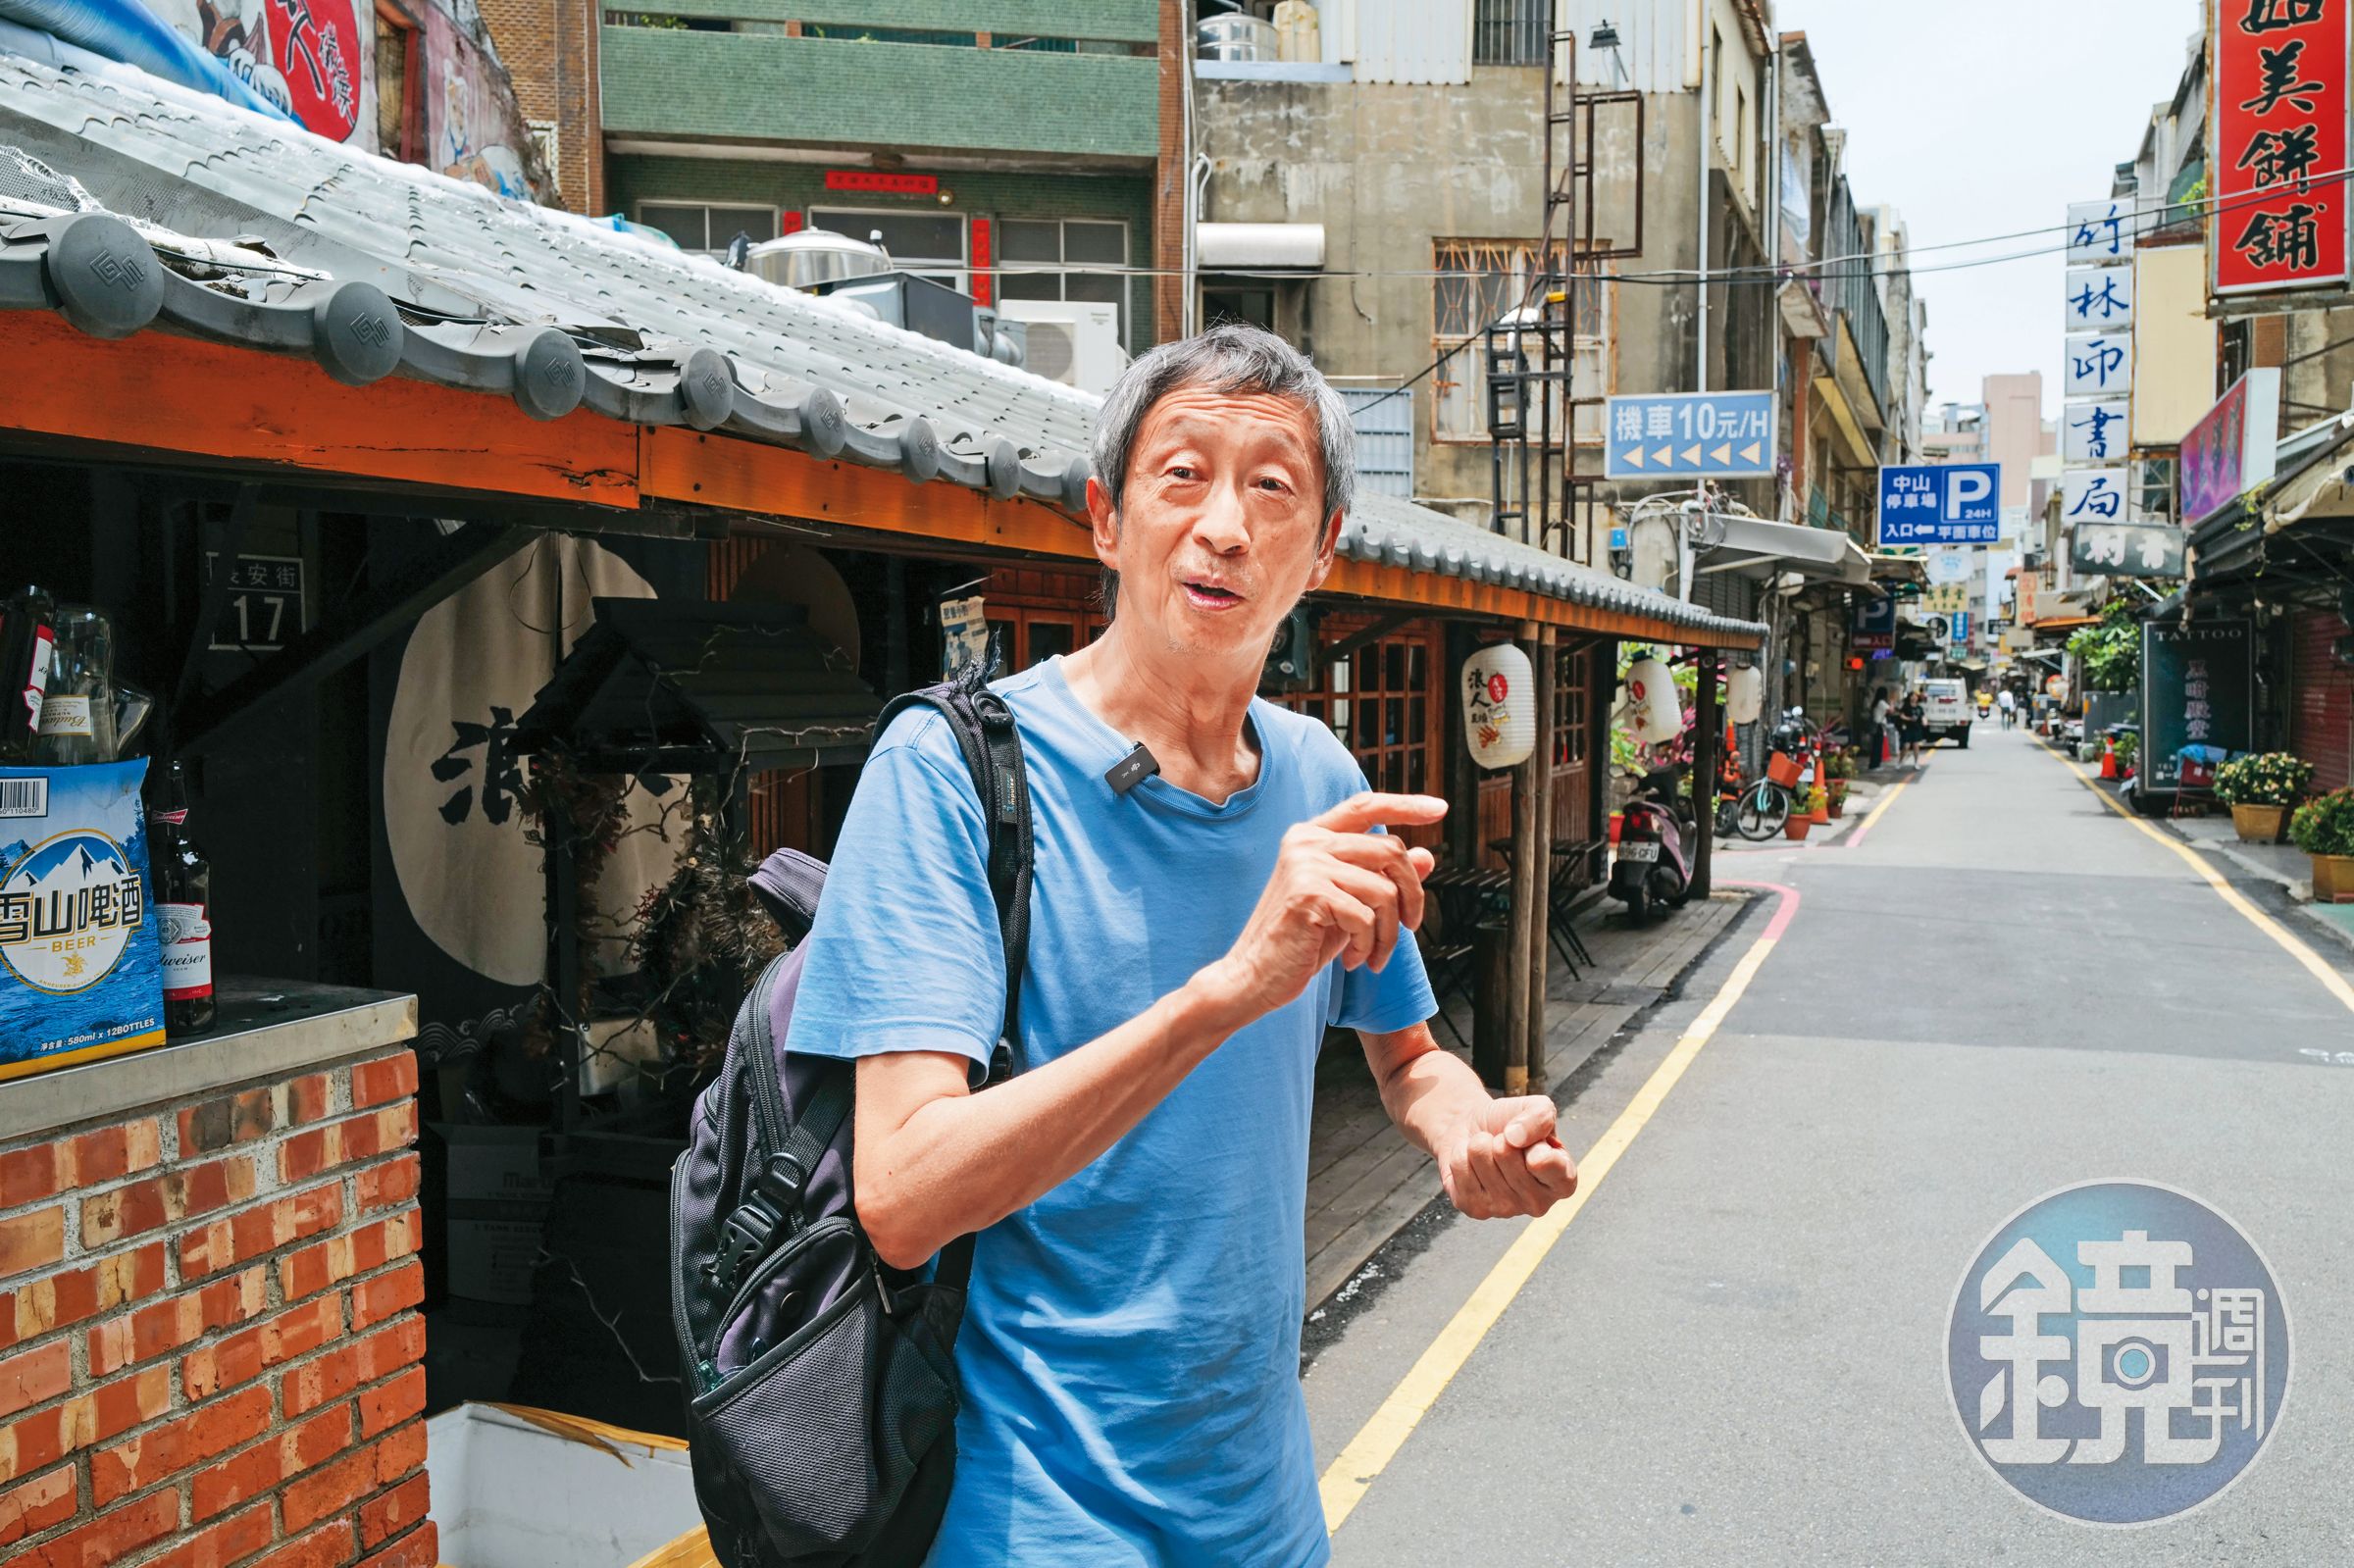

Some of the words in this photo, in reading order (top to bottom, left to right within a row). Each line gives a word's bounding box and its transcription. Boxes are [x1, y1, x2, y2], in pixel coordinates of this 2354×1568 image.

[1893, 474, 1930, 493] 中山
[1885, 492, 1937, 509] 停車場
[1947, 471, 1991, 520] P
[1965, 508, 1991, 519] 24H
[1885, 524, 1914, 538] 入口
[1938, 524, 1997, 539] 平面車位
[2084, 531, 2174, 569] 刺青
[232, 594, 284, 641] 17
[1857, 598, 1889, 629] P
[2155, 629, 2242, 641] TATTOO
[0, 876, 140, 937] 雪山啤酒
[51, 936, 96, 952] BEER
[106, 1018, 155, 1037] 12BOTTLES
